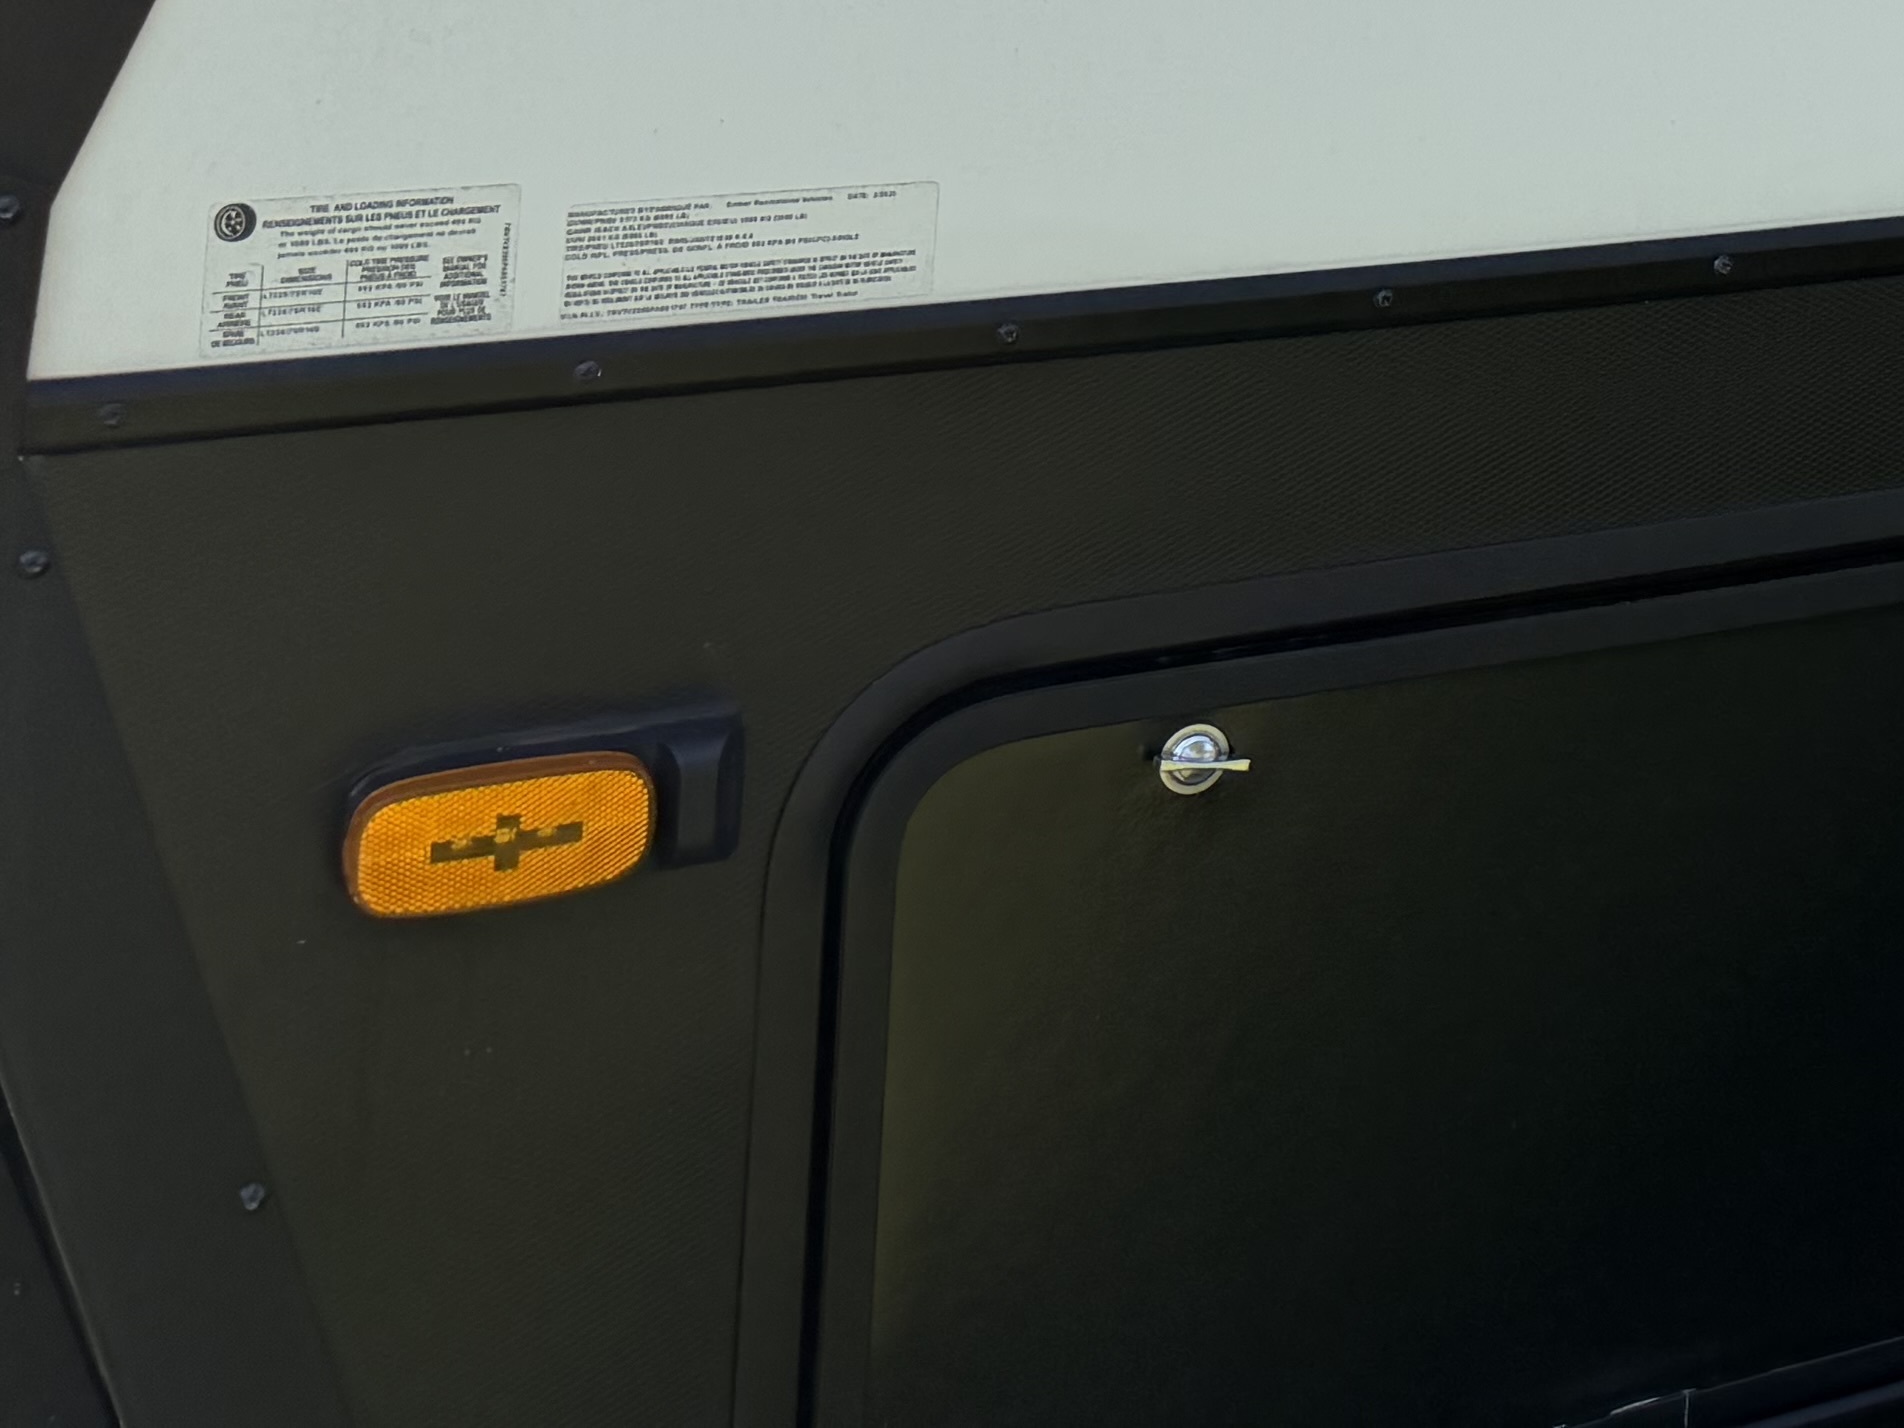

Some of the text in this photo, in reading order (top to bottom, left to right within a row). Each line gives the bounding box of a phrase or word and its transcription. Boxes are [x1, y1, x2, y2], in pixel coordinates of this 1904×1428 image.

[334, 202, 353, 212] AND
[354, 200, 394, 211] LOADING
[395, 197, 455, 208] INFORMATION
[366, 212, 382, 223] LES
[384, 210, 414, 221] PNEUS
[415, 209, 427, 219] ET
[428, 208, 440, 218] LE
